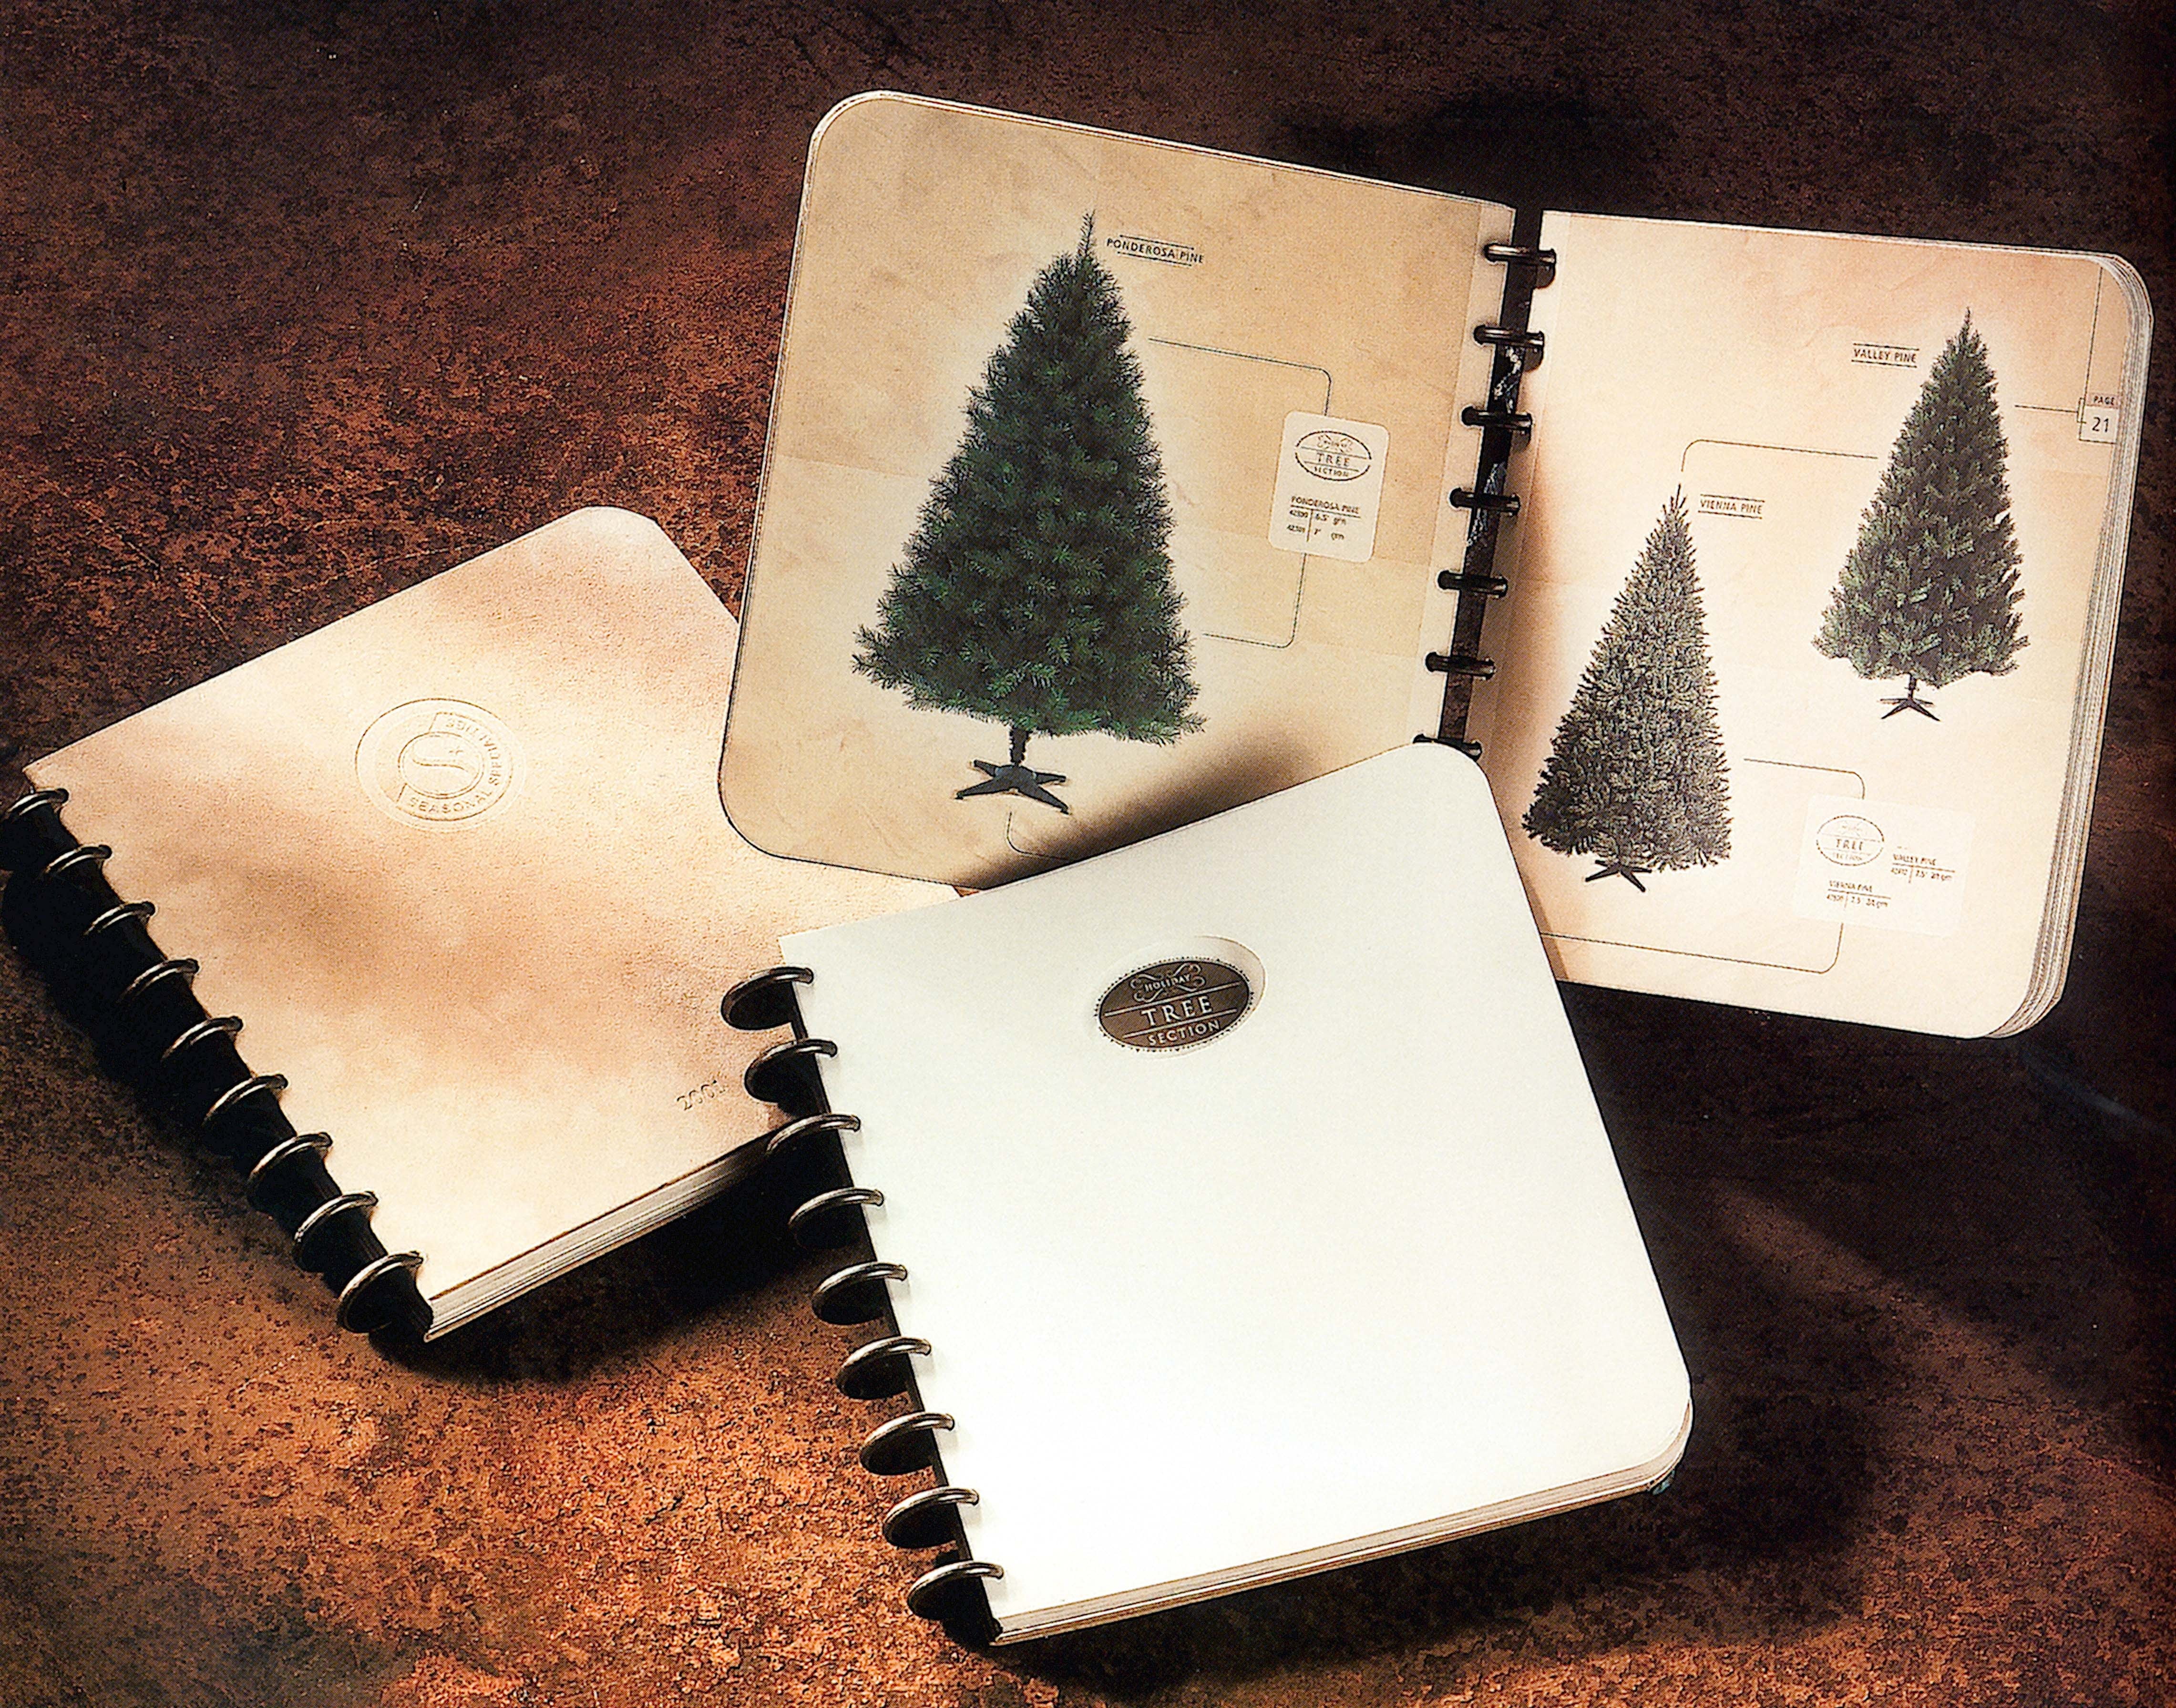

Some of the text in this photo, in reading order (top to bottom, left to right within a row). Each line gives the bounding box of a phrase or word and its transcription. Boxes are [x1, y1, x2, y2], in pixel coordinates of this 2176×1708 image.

[1107, 238, 1204, 264] PONDEROSA PINE
[1854, 349, 1917, 363] VALLEY PINE
[2094, 396, 2114, 405] PAGE
[2092, 417, 2109, 433] 21
[1317, 452, 1350, 467] TREE
[1700, 499, 1763, 514] VIENNA PINE
[409, 791, 493, 814] SEASONAL
[1144, 974, 1191, 992] HOLIDAY
[1141, 995, 1212, 1027] TREE
[1148, 1020, 1221, 1046] SECTION
